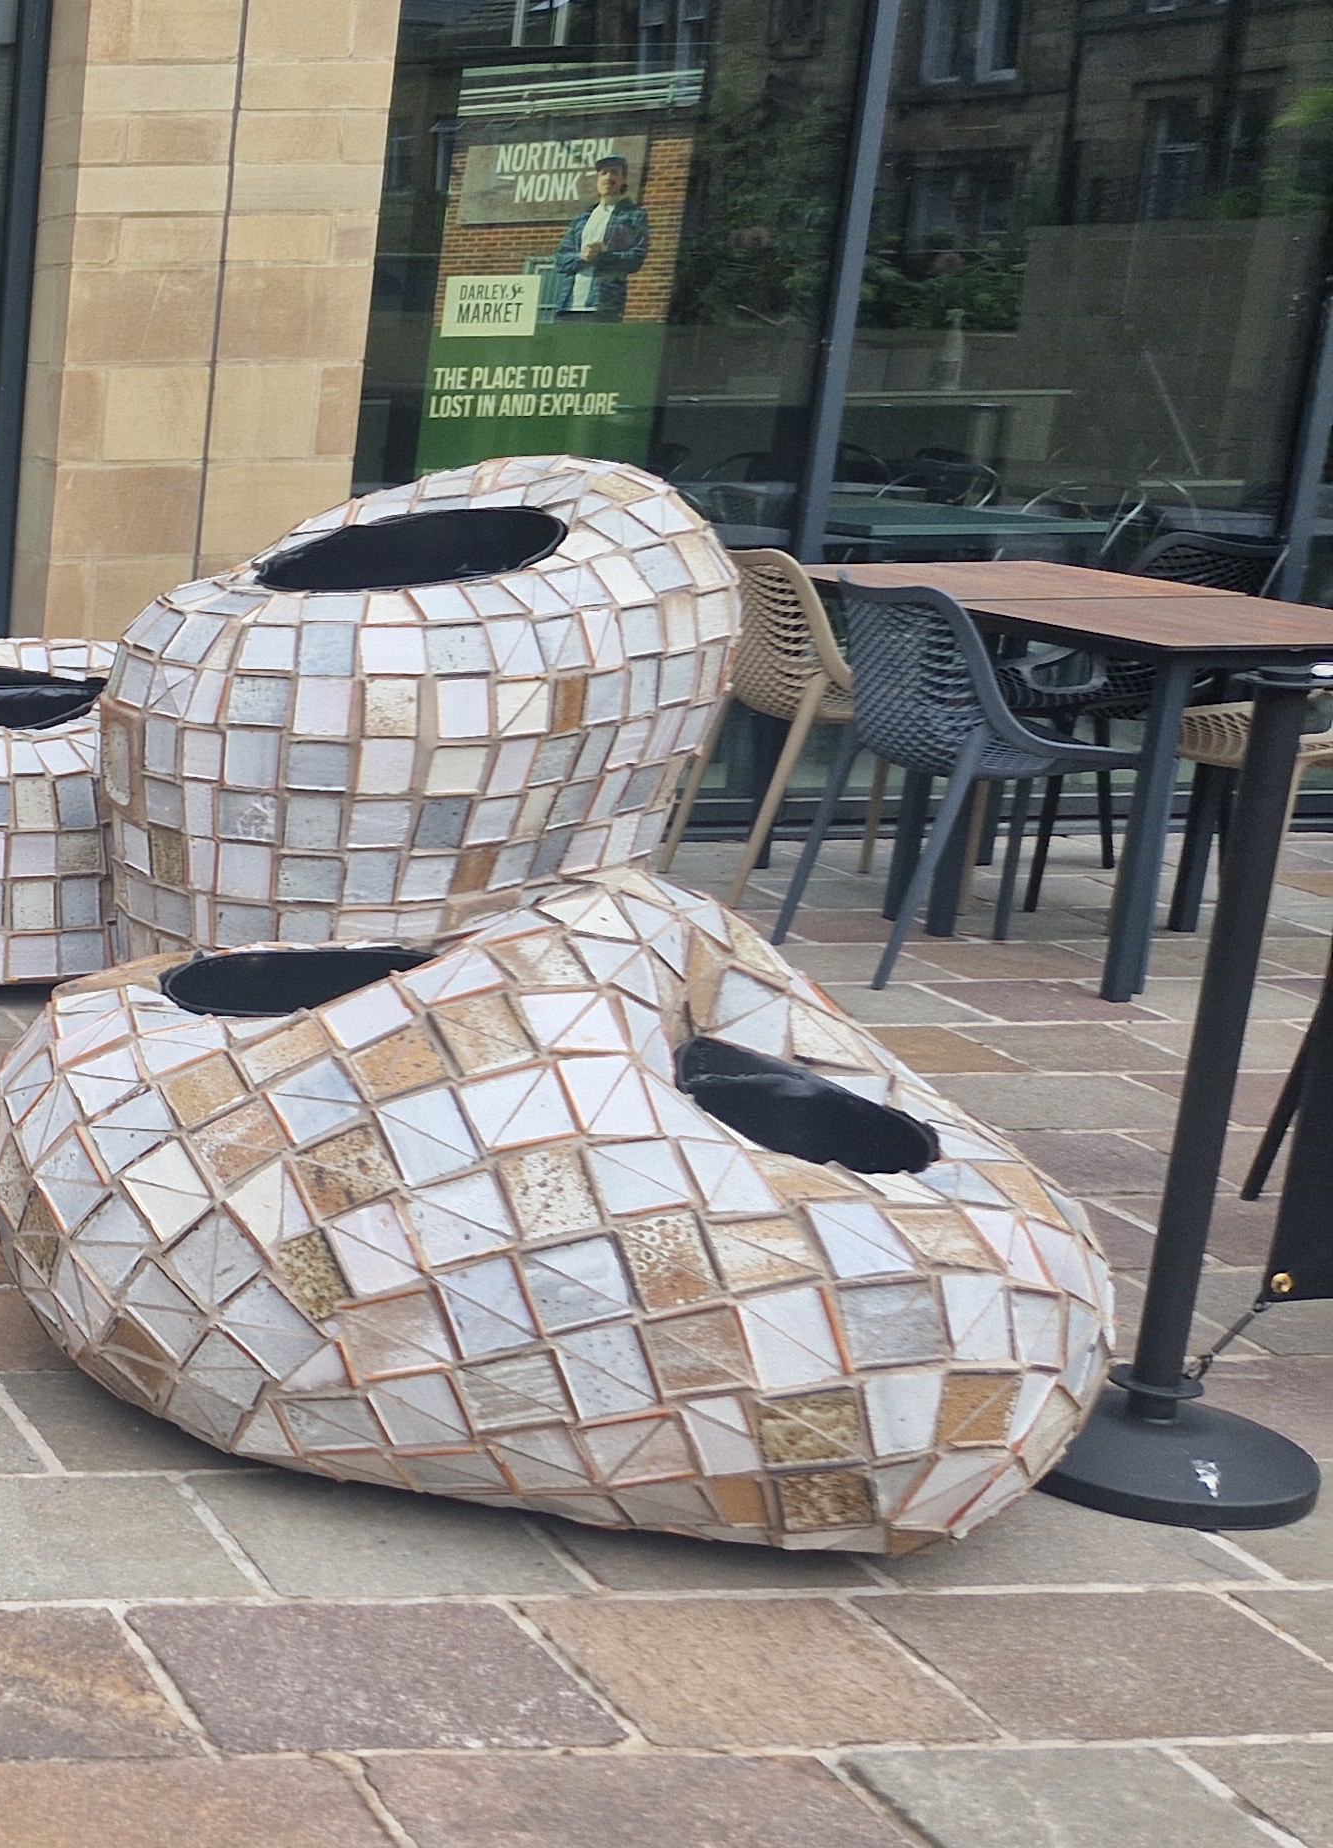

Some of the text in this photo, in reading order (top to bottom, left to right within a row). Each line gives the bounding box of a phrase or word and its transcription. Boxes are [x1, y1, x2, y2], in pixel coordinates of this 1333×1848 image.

[495, 138, 615, 173] NORTHERN
[514, 172, 582, 203] MONK
[459, 284, 508, 301] DARLEY
[456, 302, 523, 323] MARKET
[434, 365, 592, 390] THE PLACE TO GET
[429, 392, 620, 418] LOST IN AND EXPLORE
